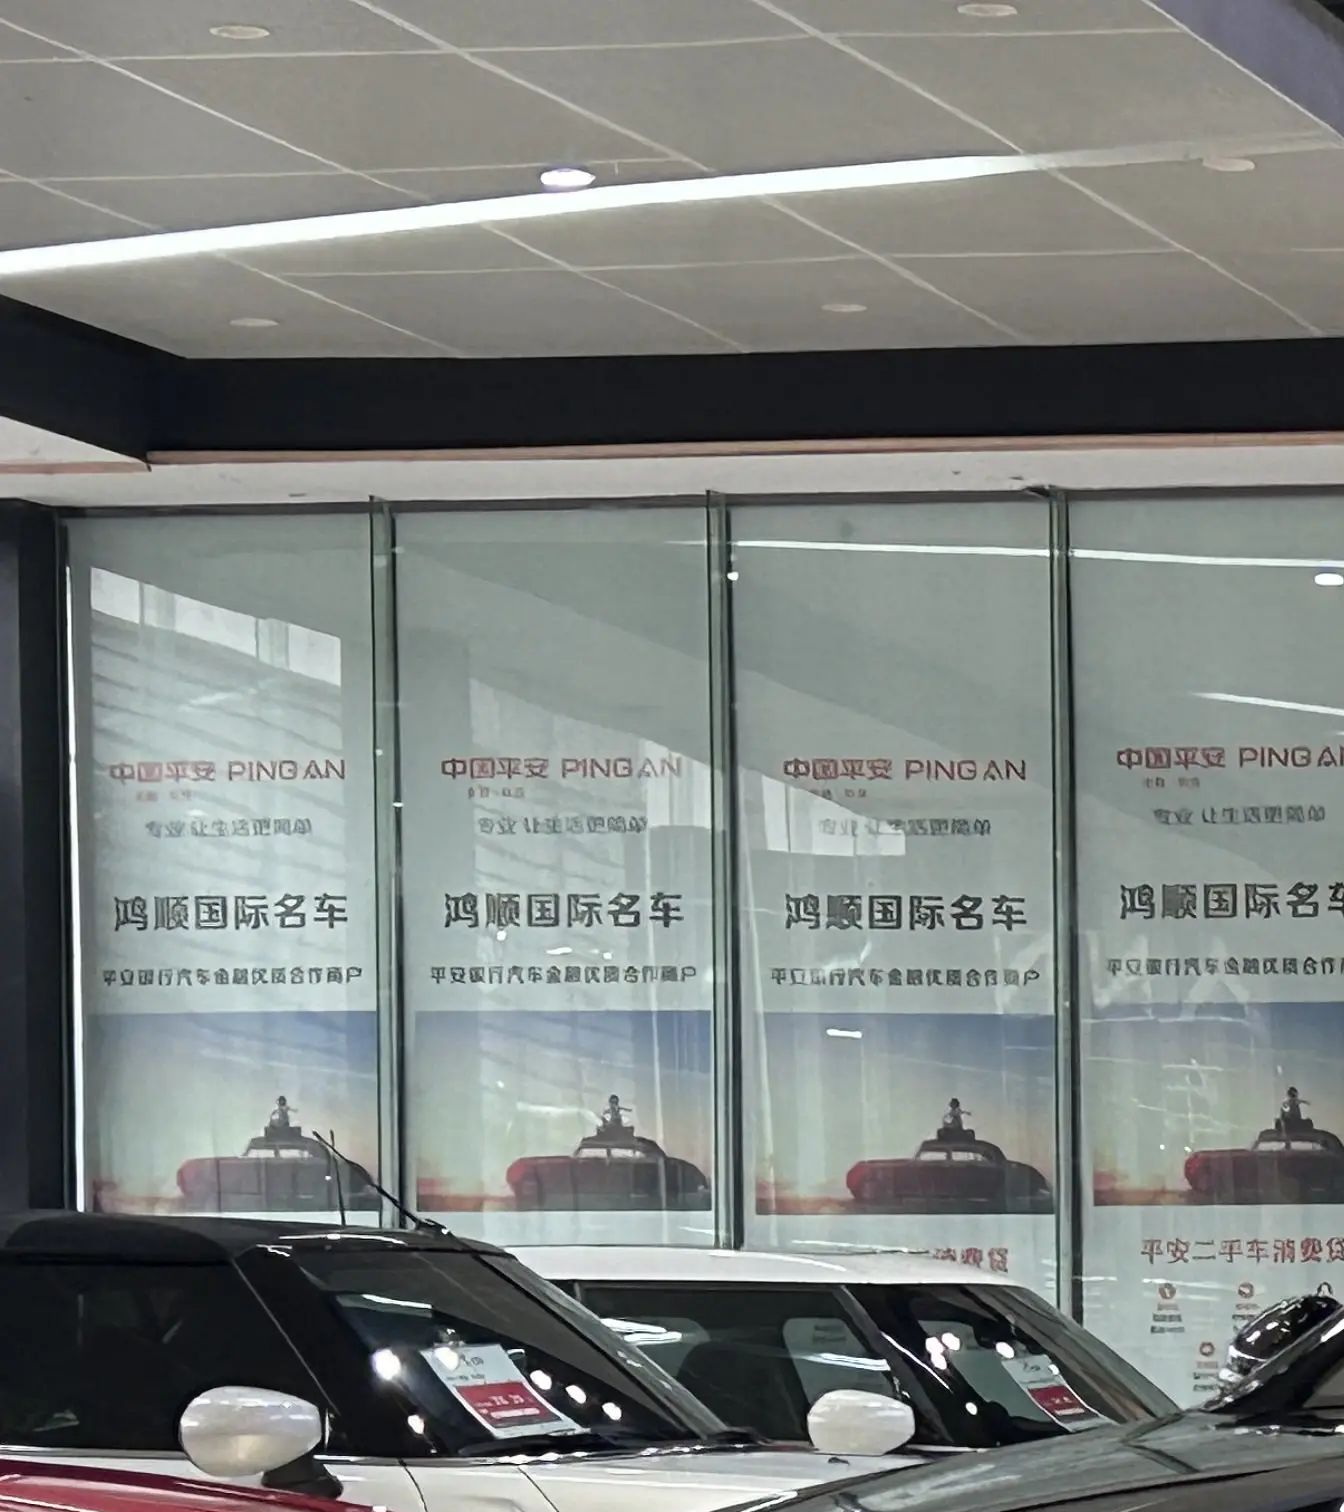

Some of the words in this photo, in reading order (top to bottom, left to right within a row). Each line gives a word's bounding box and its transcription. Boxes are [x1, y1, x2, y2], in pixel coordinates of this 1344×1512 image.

[441, 757, 549, 779] 中国平安
[784, 757, 893, 780] 中国平安
[1117, 746, 1226, 770] 中国平安
[114, 893, 348, 932] 鸿顺国际名车
[444, 891, 684, 929] 鸿顺国际名车
[784, 893, 1027, 931] 鸿顺国际名车
